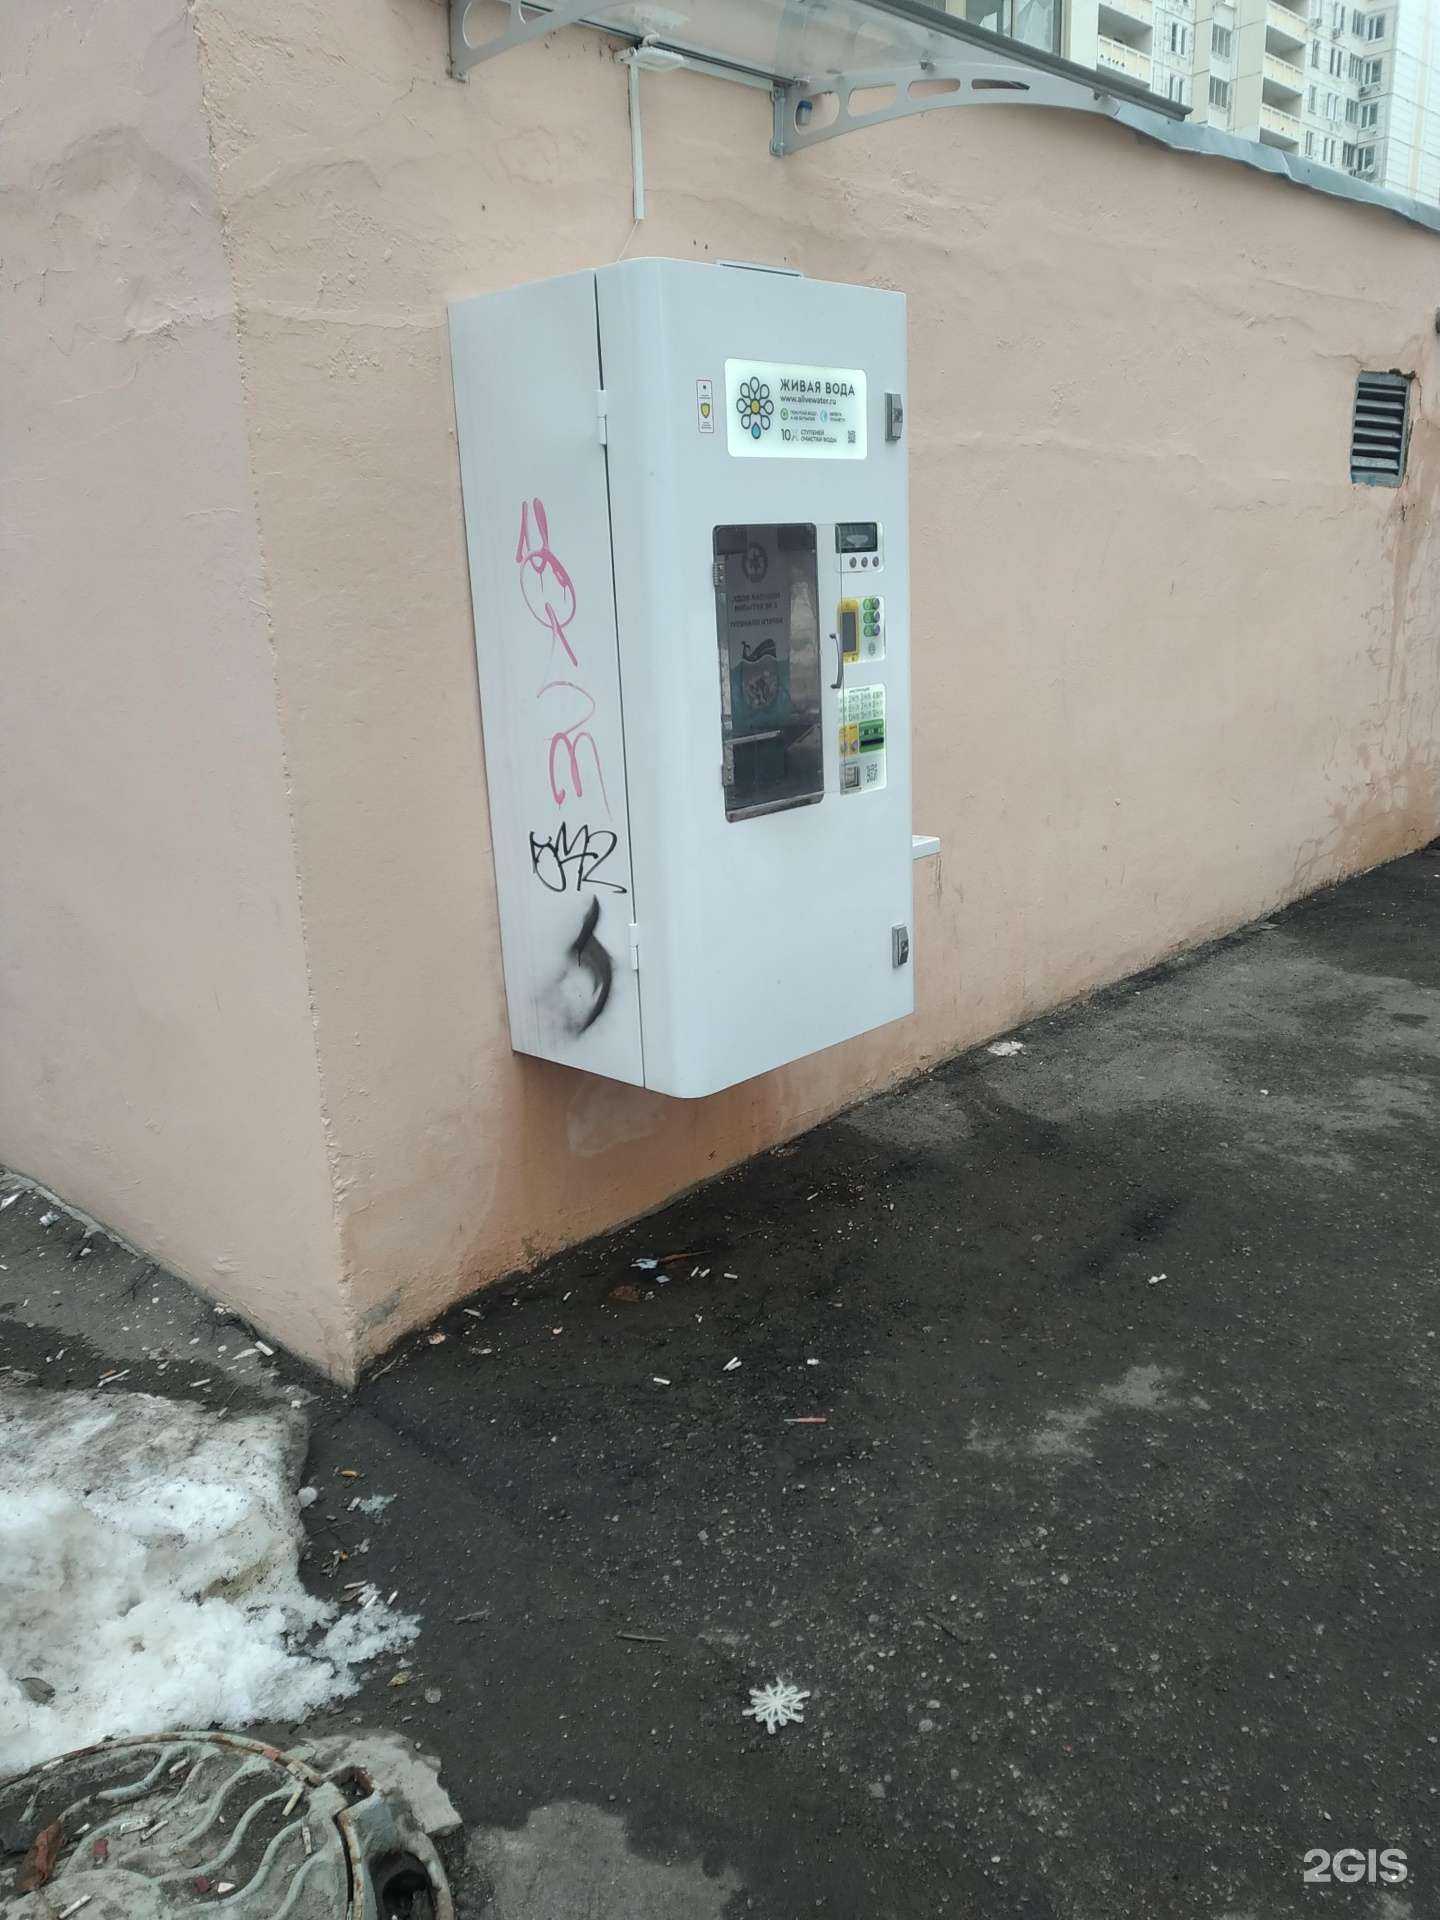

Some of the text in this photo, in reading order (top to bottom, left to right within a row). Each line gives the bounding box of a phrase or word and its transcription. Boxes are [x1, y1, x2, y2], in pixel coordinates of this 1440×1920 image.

[780, 378, 855, 397] ЖИВАЯ ВОДА
[781, 428, 791, 441] 10
